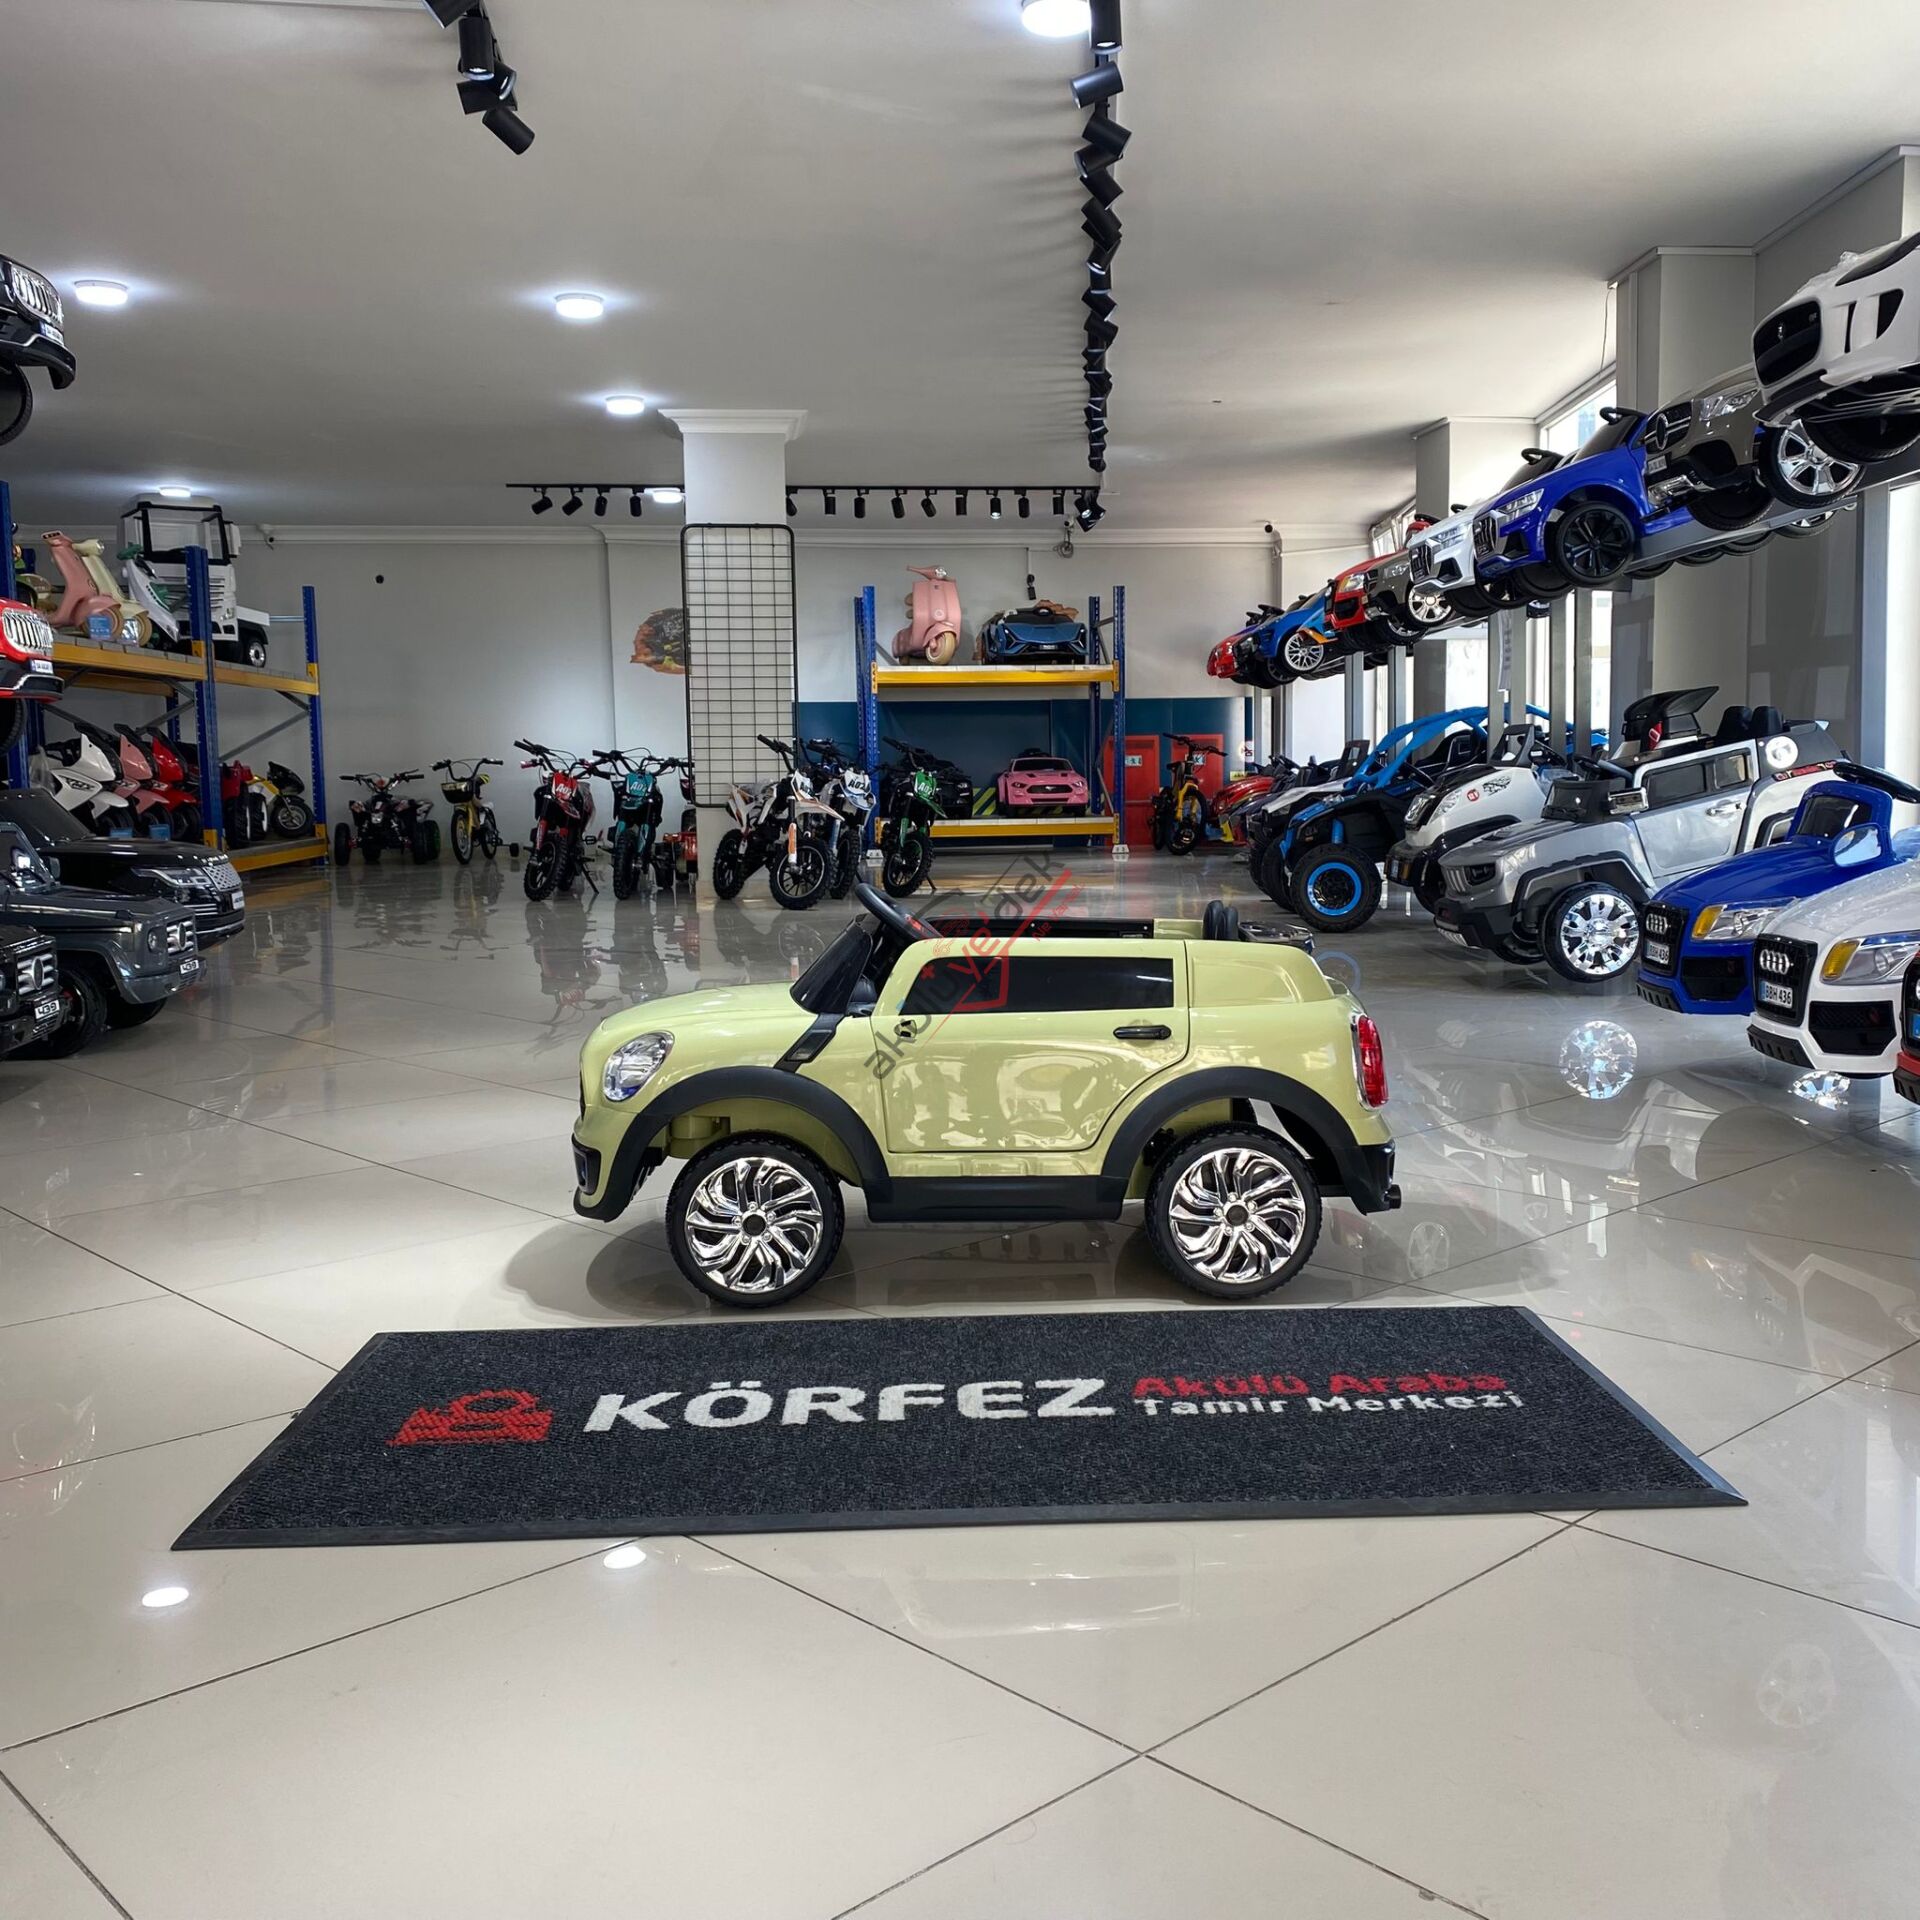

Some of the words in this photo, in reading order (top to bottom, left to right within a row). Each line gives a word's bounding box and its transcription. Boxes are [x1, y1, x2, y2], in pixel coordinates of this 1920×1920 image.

[1779, 988, 1792, 1006] 436
[1329, 1372, 1507, 1394] Araba
[583, 1378, 1116, 1433] KÖRFEZ
[1135, 1396, 1288, 1416] Tamir
[1306, 1391, 1524, 1413] Merkezi
